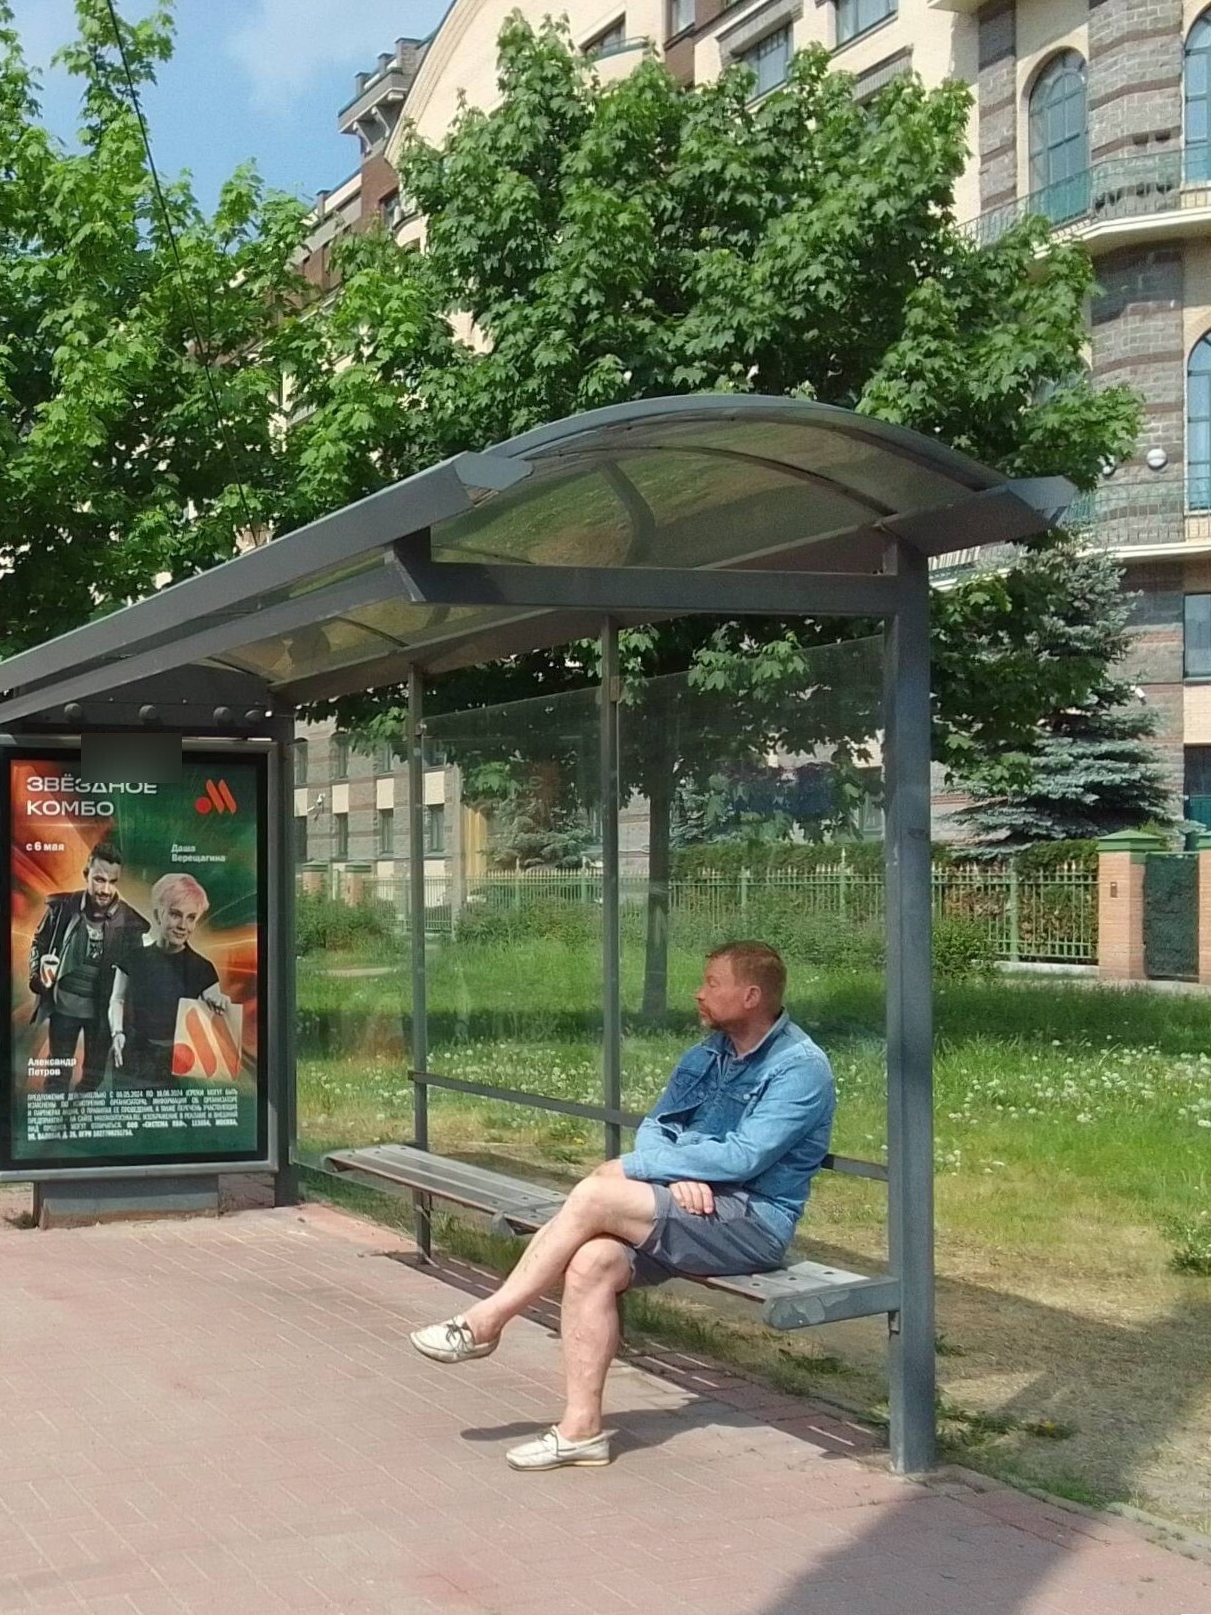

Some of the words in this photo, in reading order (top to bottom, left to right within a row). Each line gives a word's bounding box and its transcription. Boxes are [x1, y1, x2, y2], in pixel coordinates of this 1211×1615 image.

[26, 773, 157, 794] ЗВЁЗДНОЕ
[26, 800, 114, 816] КОМБО
[34, 842, 42, 851] 6
[43, 843, 65, 851] мая
[171, 844, 196, 854] Даша
[172, 854, 226, 863] Верещагина
[27, 1058, 77, 1067] Александр
[28, 1068, 61, 1077] Петров
